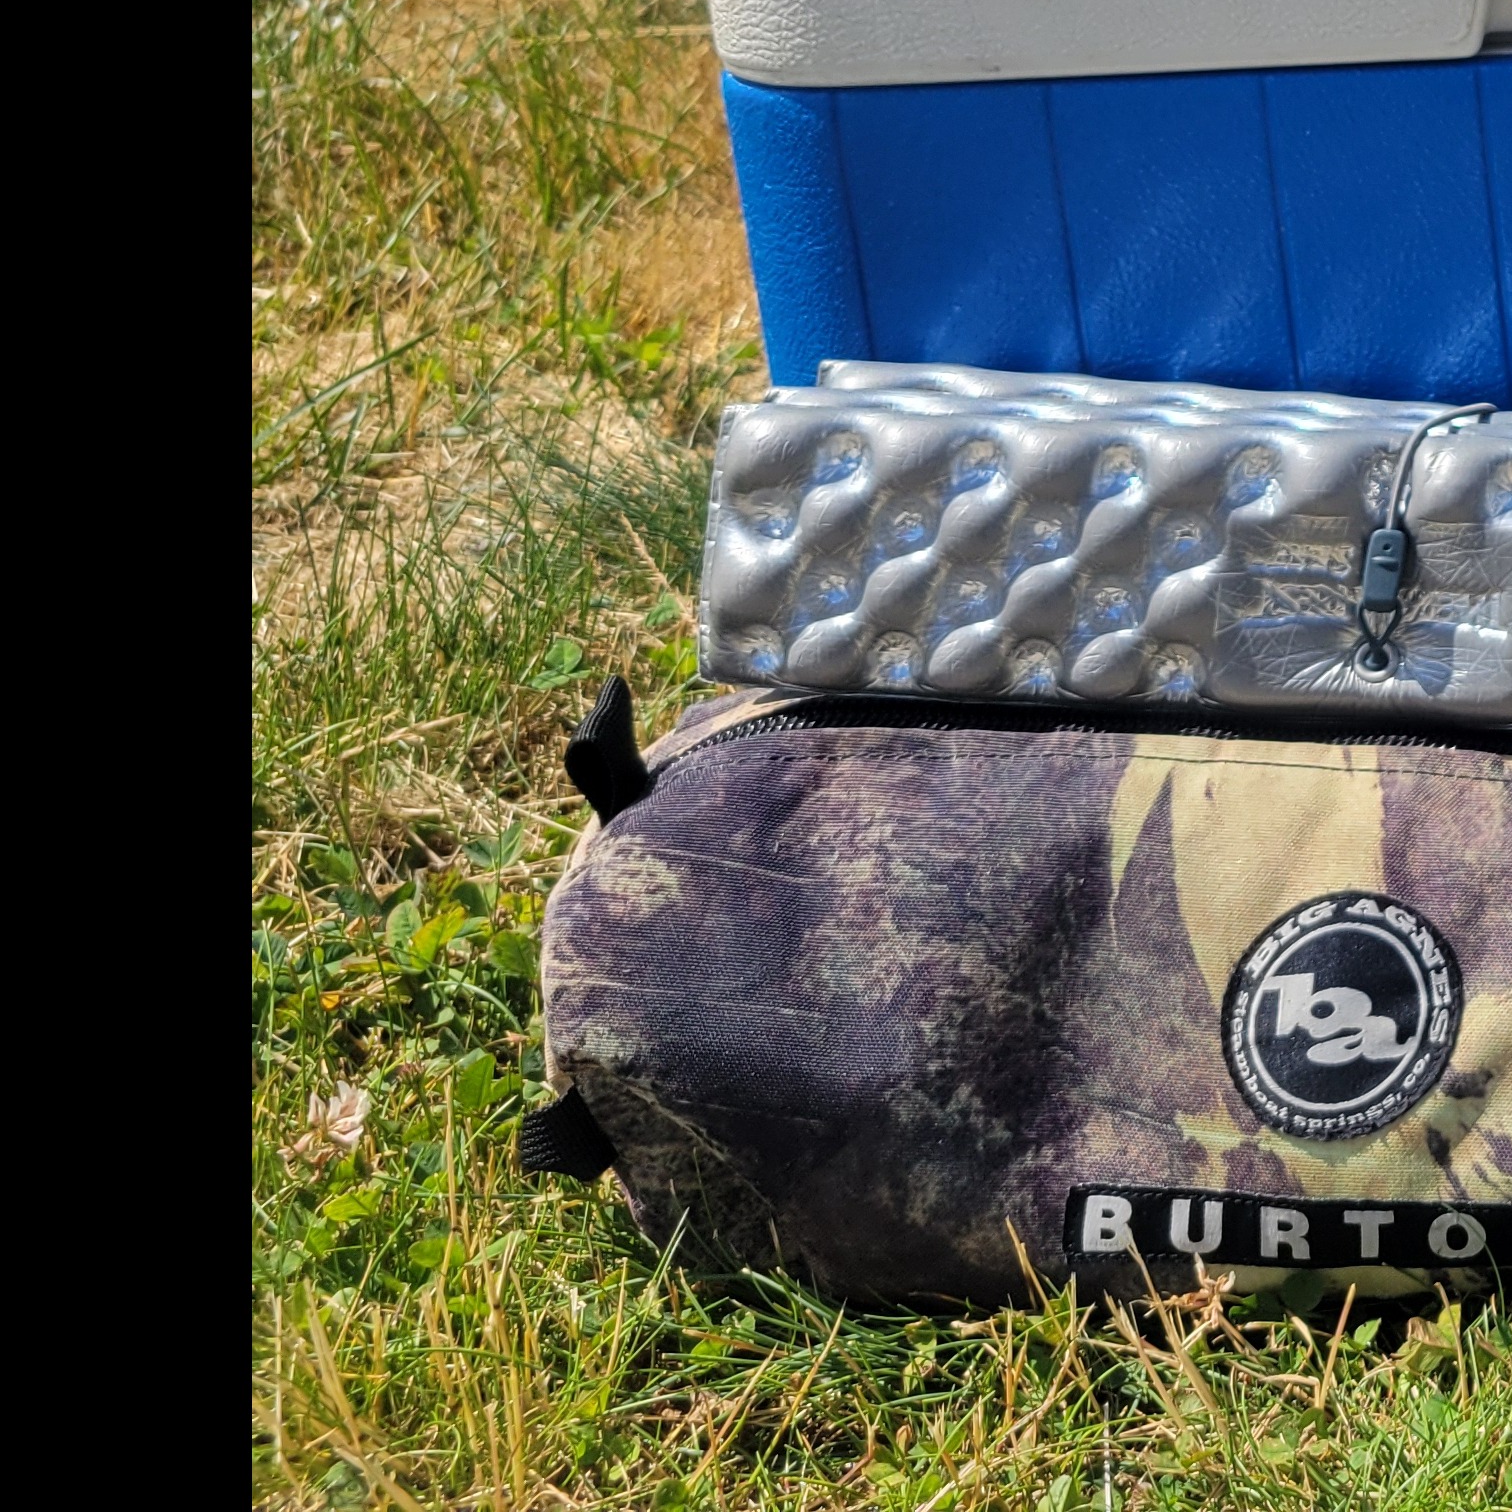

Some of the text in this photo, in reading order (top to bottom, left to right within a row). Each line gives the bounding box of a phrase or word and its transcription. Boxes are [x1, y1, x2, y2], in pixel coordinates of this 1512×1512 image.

[1244, 898, 1451, 1045] BIG AGNES
[1232, 990, 1289, 1119] steamboat
